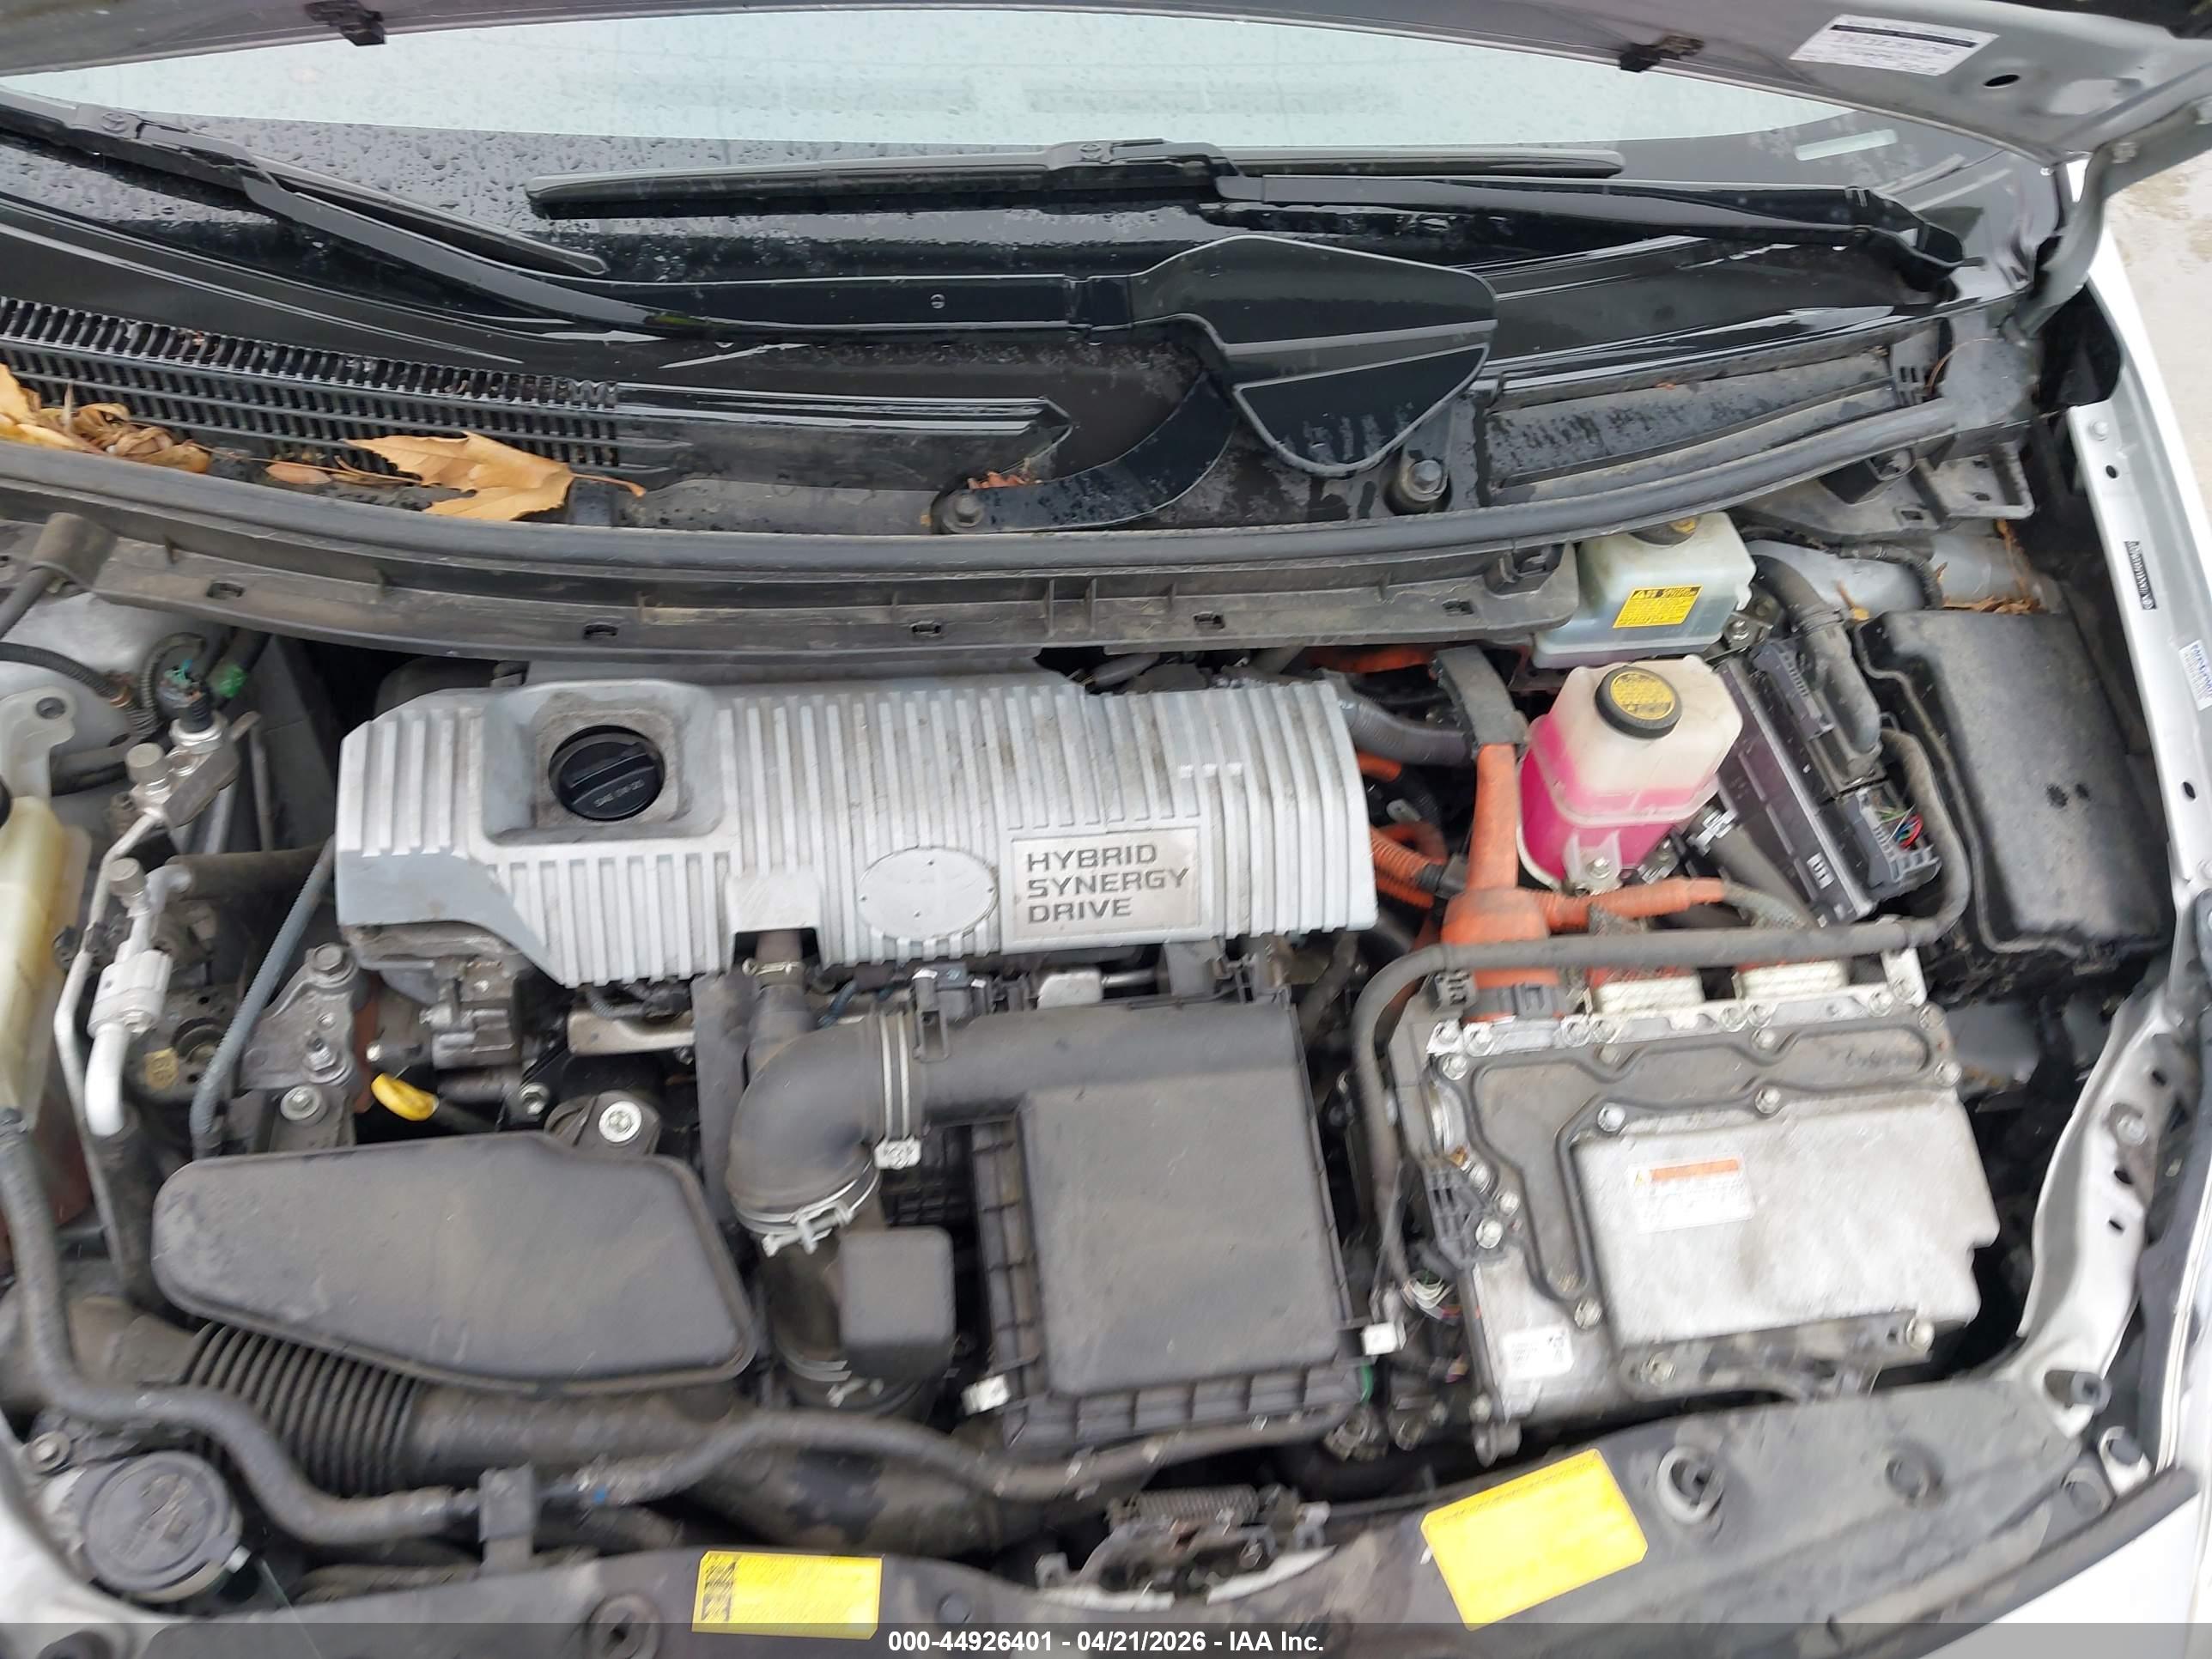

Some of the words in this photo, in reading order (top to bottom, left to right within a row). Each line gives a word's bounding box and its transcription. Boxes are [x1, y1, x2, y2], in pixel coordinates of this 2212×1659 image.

[1027, 844, 1158, 872] HYBRID
[1027, 867, 1190, 899] SYNERGY
[1027, 897, 1133, 924] DRIVE
